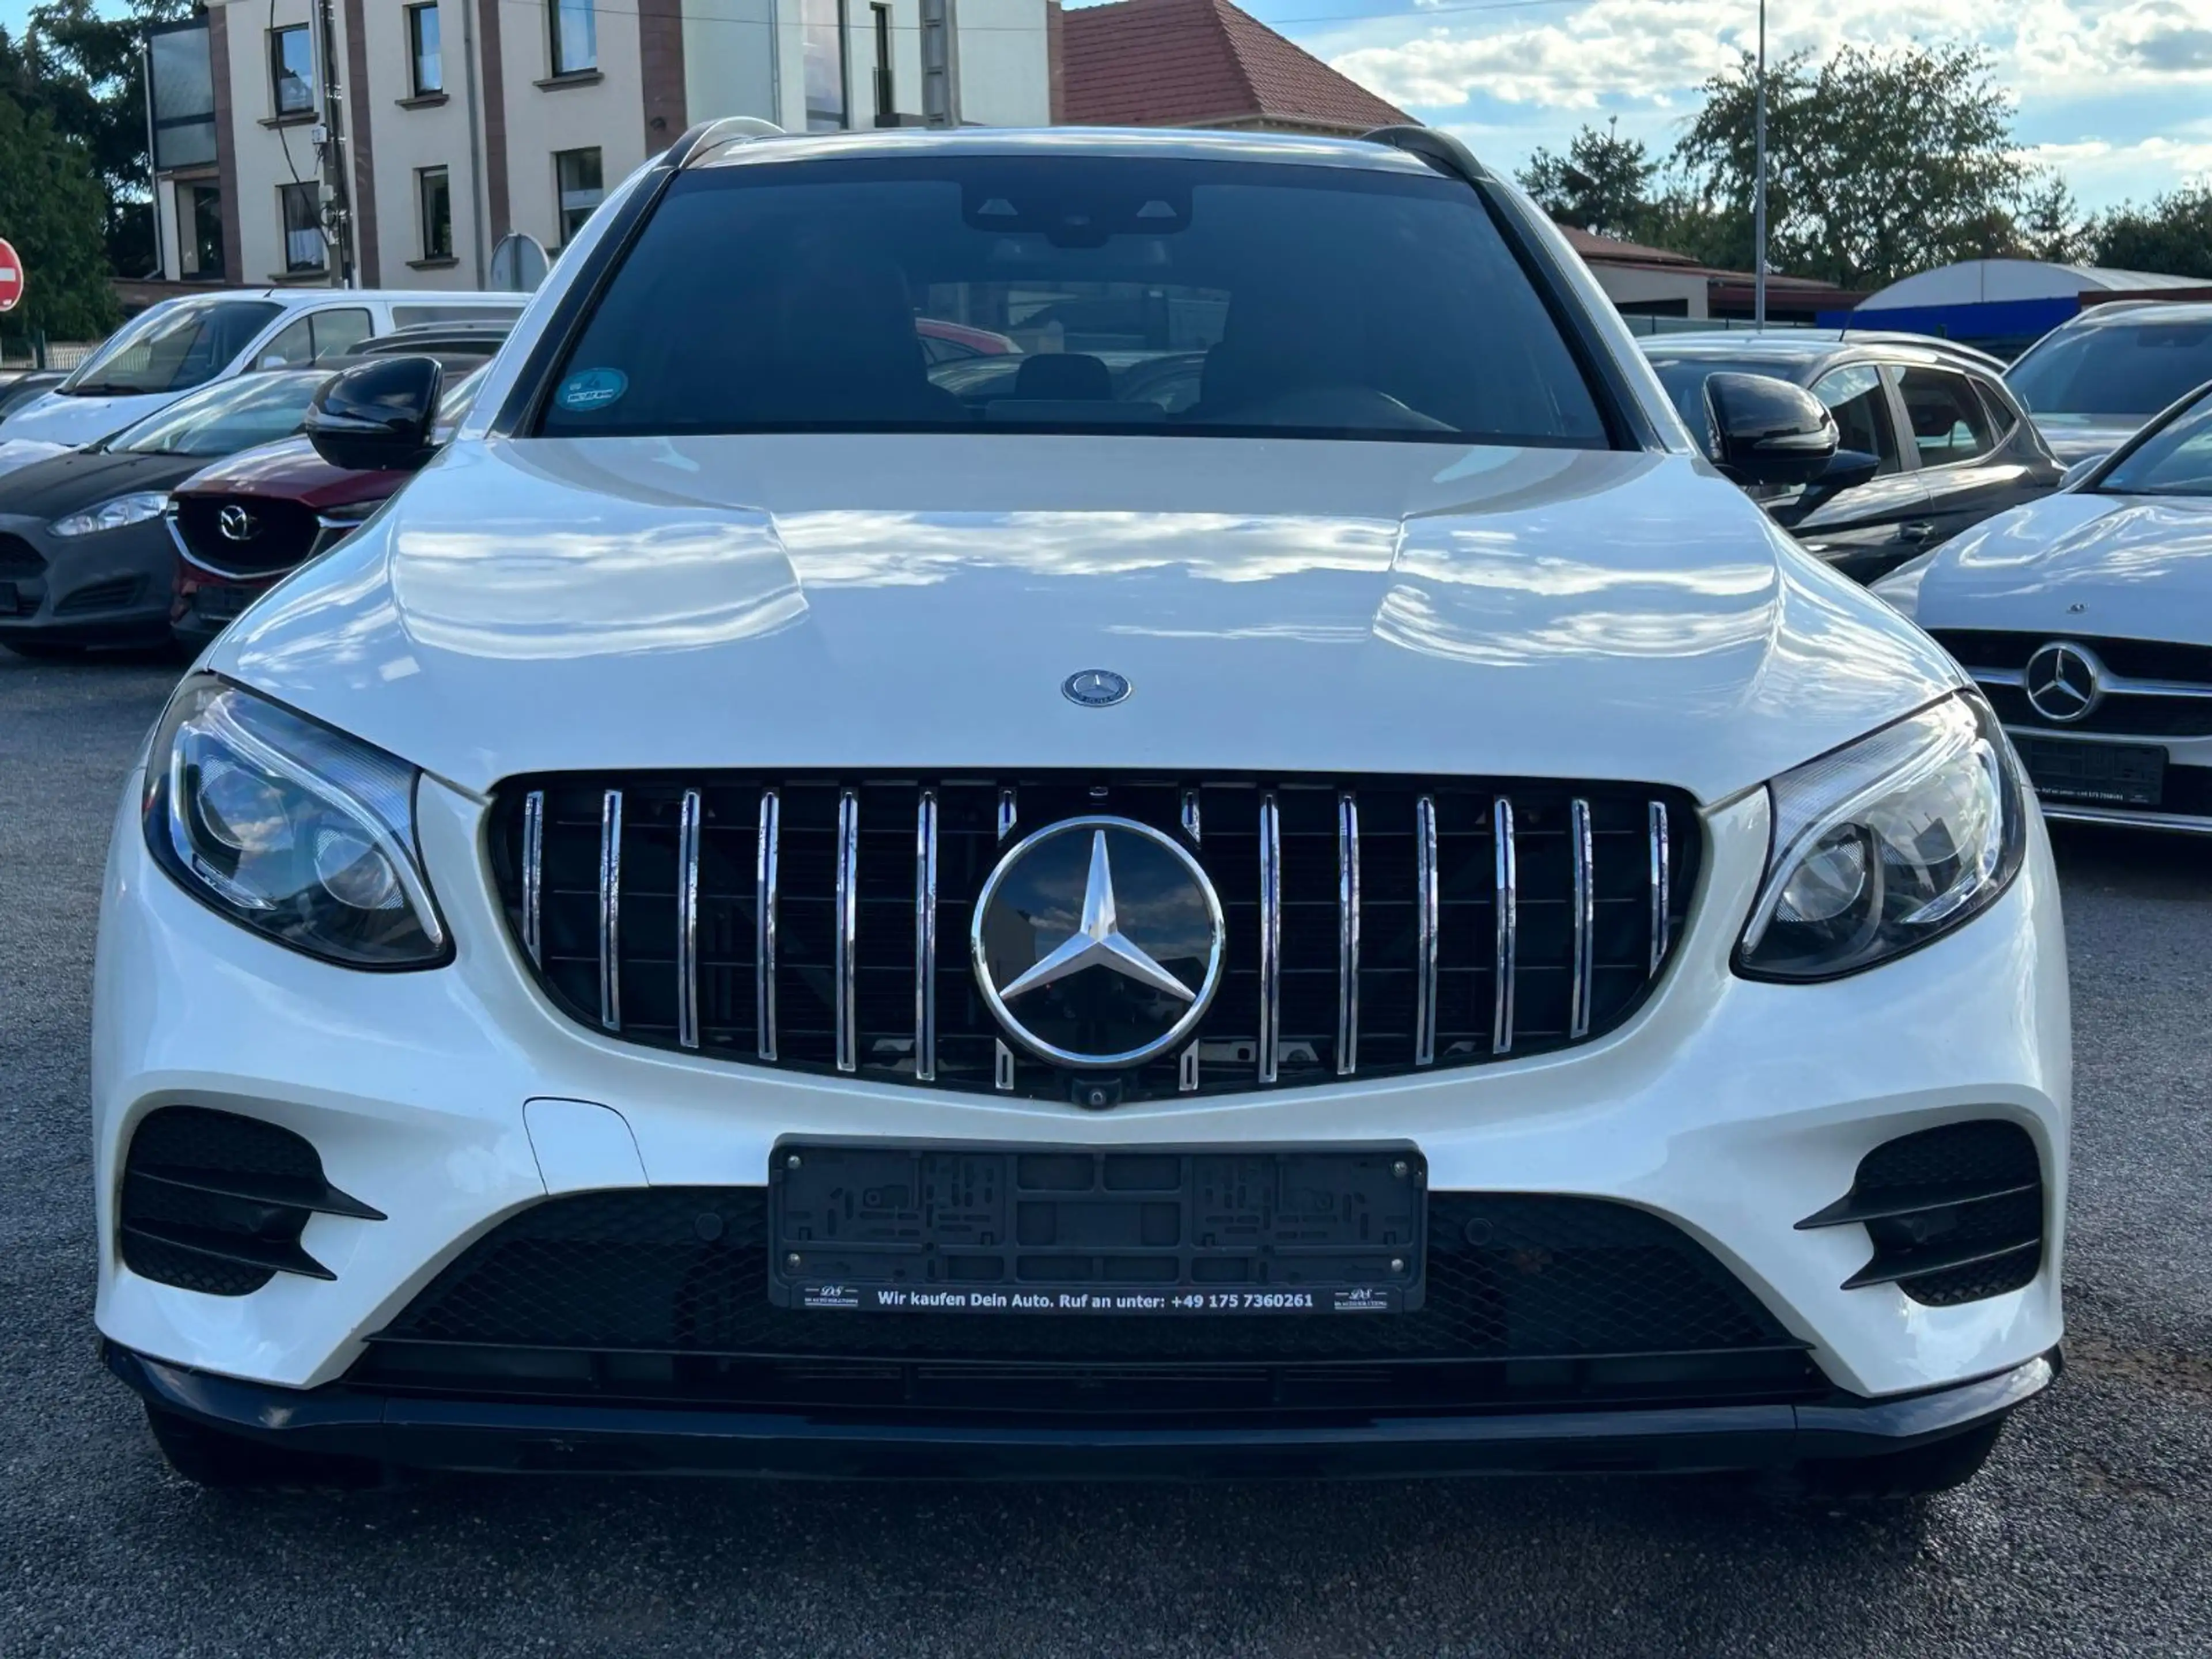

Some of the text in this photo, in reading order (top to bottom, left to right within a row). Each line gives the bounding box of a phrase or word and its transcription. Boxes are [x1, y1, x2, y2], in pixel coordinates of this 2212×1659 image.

[877, 1291, 1313, 1308] Wir kaufen Dein Auto. Ruf an unter: +49 175 7360261
